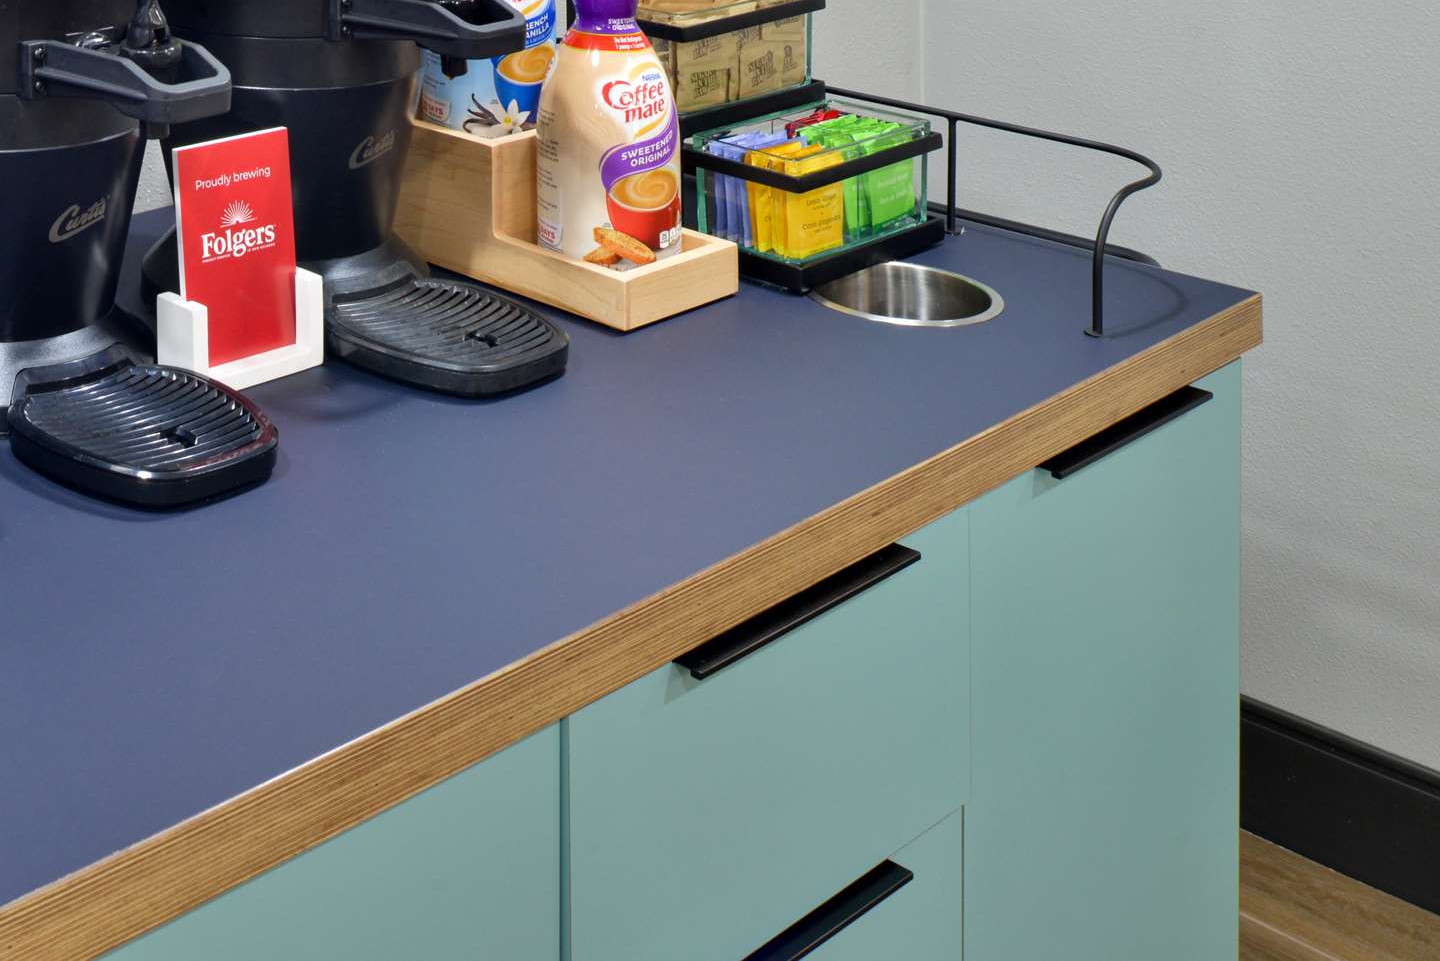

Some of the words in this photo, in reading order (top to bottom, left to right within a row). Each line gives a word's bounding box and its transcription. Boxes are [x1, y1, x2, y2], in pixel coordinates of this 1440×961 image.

[602, 81, 664, 110] Coffee
[625, 99, 665, 123] mate
[621, 129, 673, 161] SWEETENED
[630, 147, 671, 168] ORIGINAL
[195, 174, 231, 191] Proudly
[233, 167, 271, 182] brewing
[201, 224, 276, 258] Folgers
